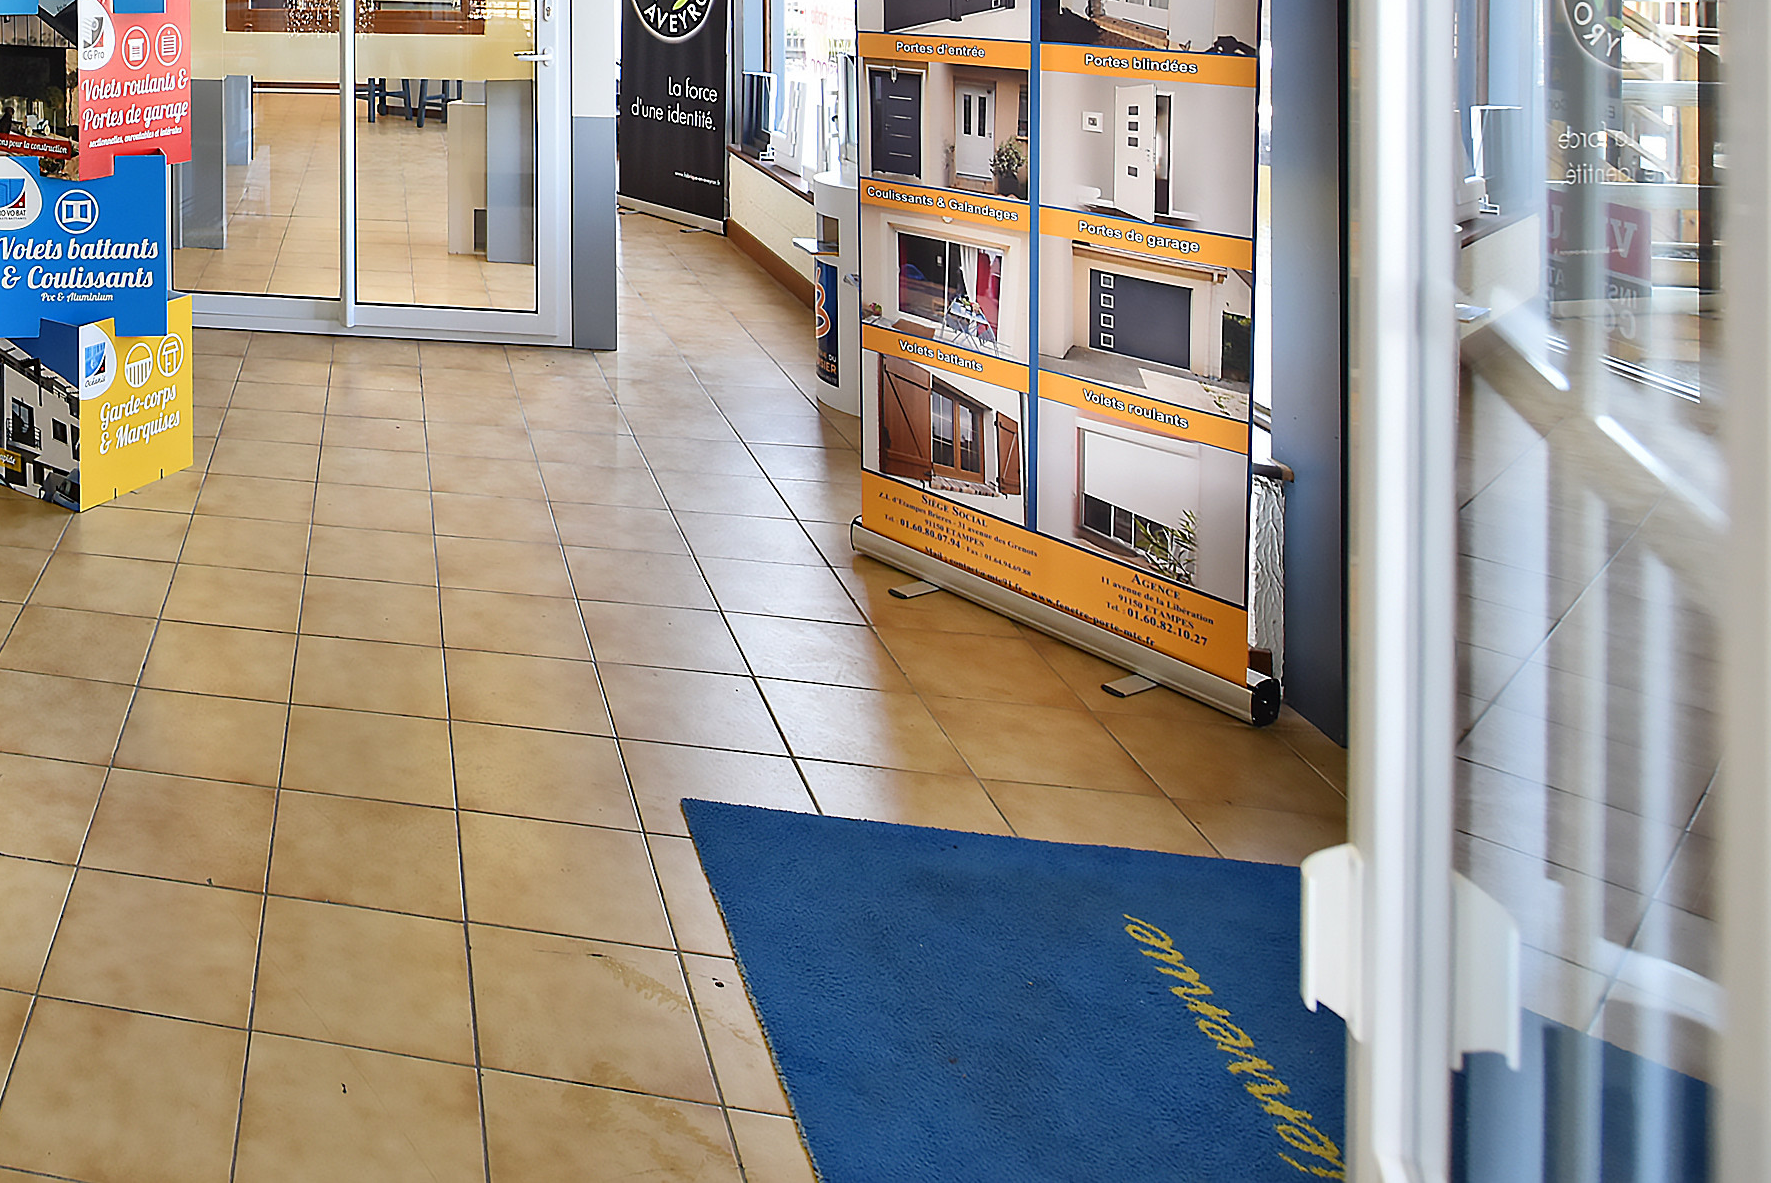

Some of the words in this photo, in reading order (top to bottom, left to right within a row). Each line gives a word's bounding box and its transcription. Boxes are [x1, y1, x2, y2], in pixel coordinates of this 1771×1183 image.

[82, 50, 93, 60] CG
[93, 49, 105, 60] Pro
[895, 41, 934, 56] Portes
[936, 44, 986, 59] d'entrée
[1084, 53, 1130, 70] Portes
[1132, 55, 1199, 75] blindées
[81, 78, 122, 102] Volets
[122, 71, 176, 97] roulants
[177, 68, 189, 90] &
[685, 76, 718, 103] force
[82, 106, 124, 131] Portes
[125, 104, 138, 124] de
[138, 101, 189, 129] garage
[631, 96, 664, 121] d'une
[667, 102, 716, 131] identité.
[8, 138, 23, 151] pour
[23, 139, 30, 150] la
[30, 140, 68, 155] construction
[866, 185, 935, 207] Coulissants
[936, 196, 947, 208] &
[948, 198, 1020, 222] Galandages
[67, 237, 159, 260] battants
[1078, 220, 1123, 239] Portes
[1124, 228, 1144, 243] de
[1146, 231, 1201, 254] garage
[0, 265, 22, 290] &
[27, 265, 154, 290] Coulissants
[40, 292, 56, 302] Pvc
[66, 292, 114, 303] Aluminium
[898, 338, 934, 359] Volets
[936, 349, 984, 373] battants
[99, 384, 177, 431] Garde-corps
[1082, 387, 1125, 412] Volets
[1128, 402, 1189, 430] roulants
[99, 431, 112, 455] &
[114, 410, 181, 450] Marquises
[900, 518, 962, 549] 01.60.80.07.94
[968, 525, 993, 541] avenue
[993, 535, 1006, 546] des
[1101, 575, 1111, 585] 11
[1112, 581, 1142, 598] avenue
[1144, 591, 1154, 602] de
[1156, 596, 1165, 607] la
[1166, 601, 1215, 626] Libération
[1118, 593, 1143, 610] 91150
[1145, 604, 1196, 630] ETAMPES
[1127, 607, 1209, 647] 01.60.82.10.27
